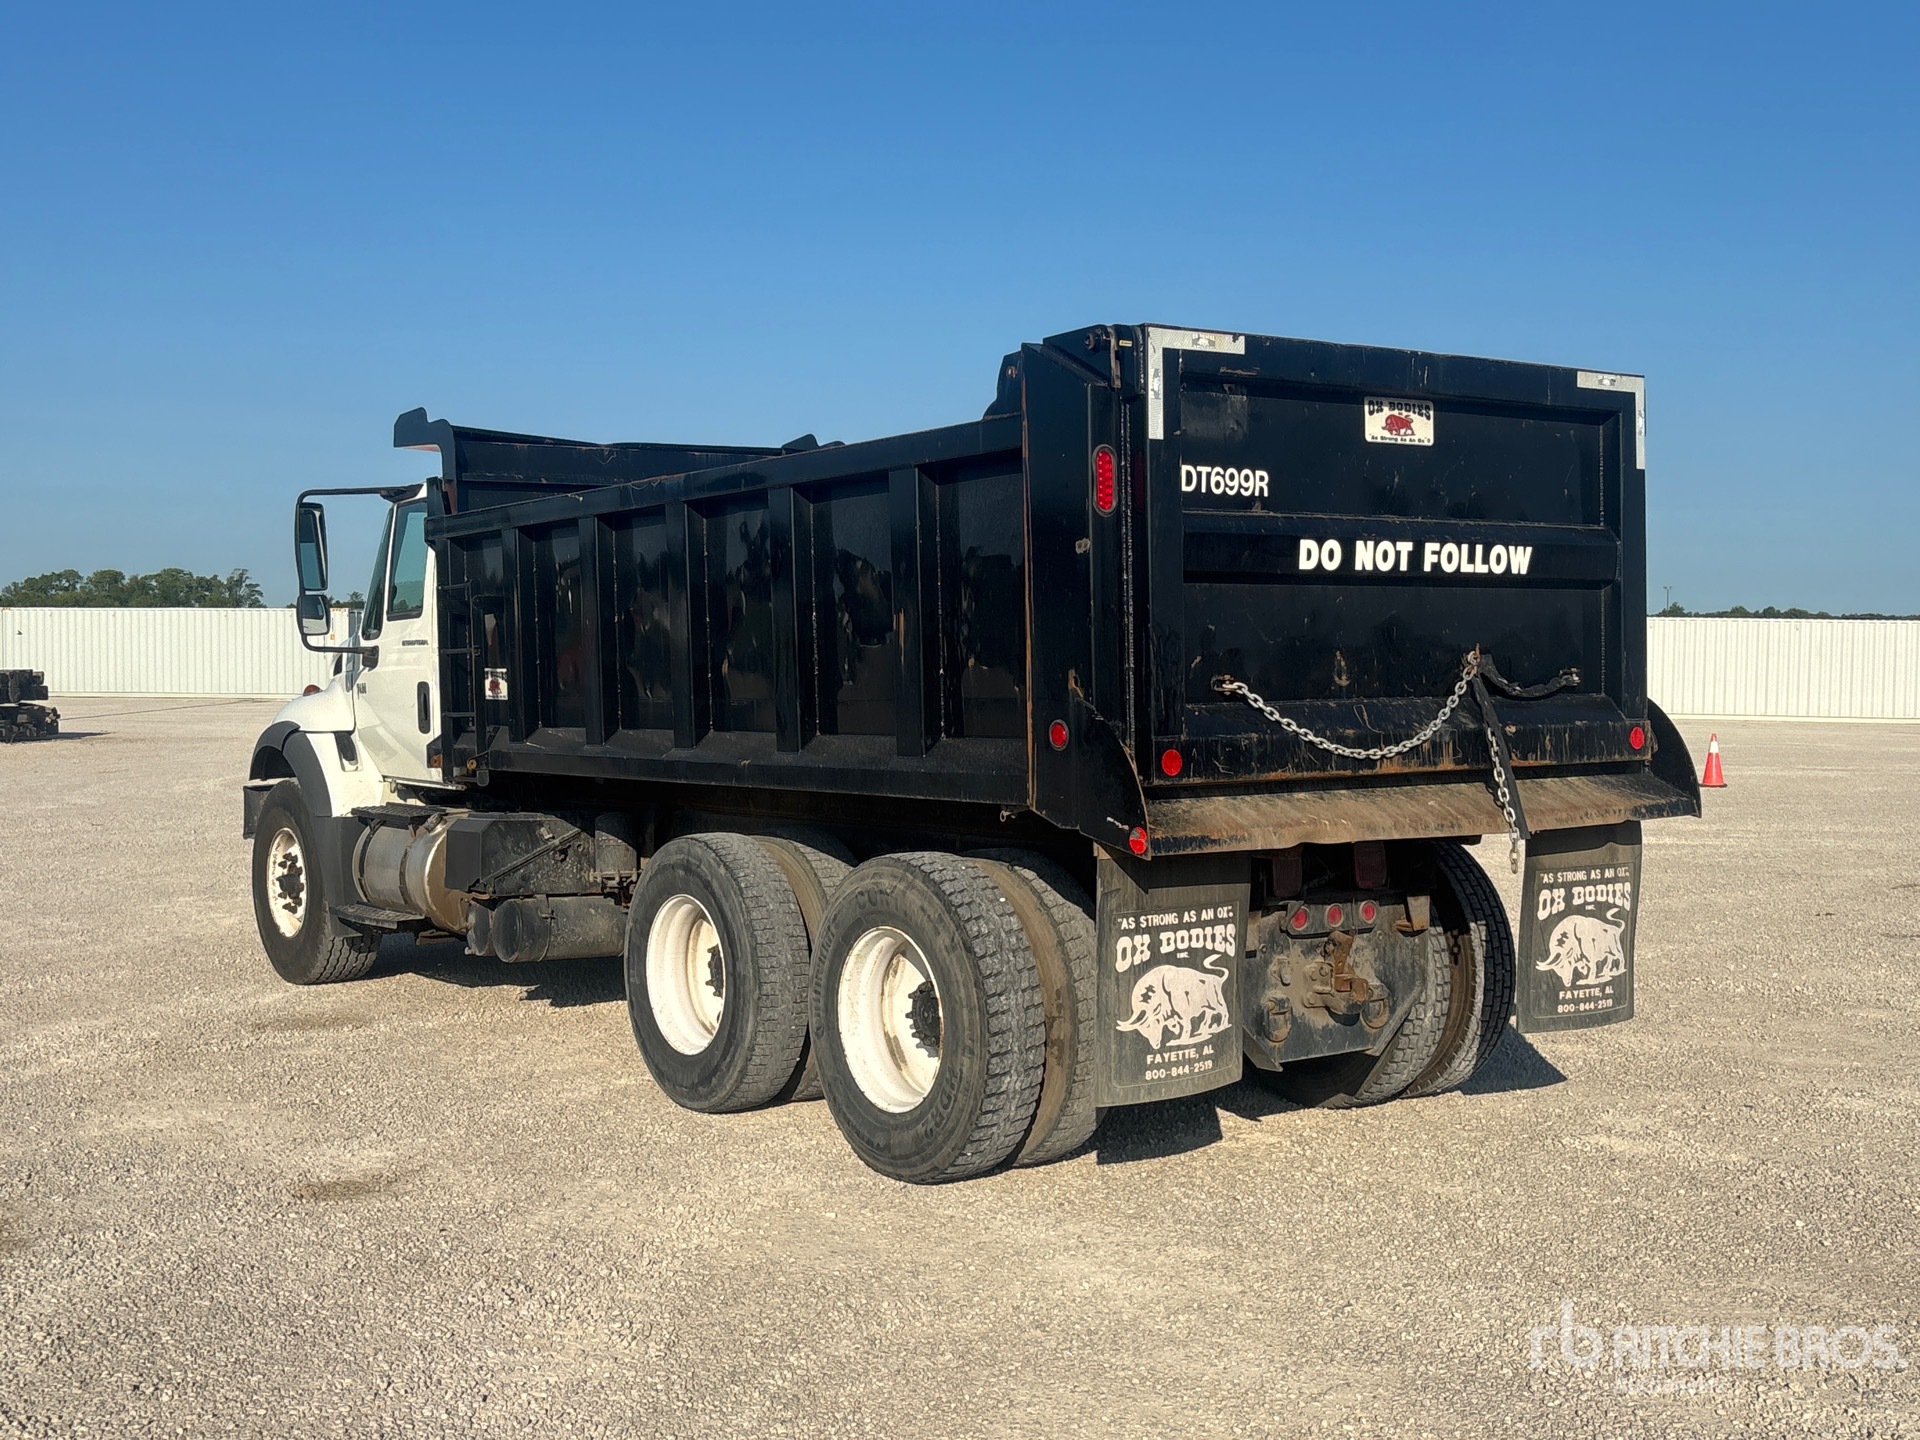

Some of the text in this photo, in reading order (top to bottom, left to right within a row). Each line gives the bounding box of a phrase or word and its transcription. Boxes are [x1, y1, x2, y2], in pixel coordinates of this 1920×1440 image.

[1368, 400, 1431, 421] OX BODIES
[1181, 465, 1269, 497] DT699R
[1298, 539, 1533, 575] DO NOT FOLLOW
[1557, 870, 1587, 883] STRONG
[1590, 869, 1601, 880] AS
[1604, 867, 1615, 879] AN
[1537, 881, 1631, 921] OX BODIES
[1139, 912, 1179, 929] STRONG
[1183, 910, 1197, 924] AS
[1201, 908, 1214, 921] AN
[1116, 923, 1236, 973] OX BODIES
[1604, 985, 1615, 995] AL
[1146, 1045, 1215, 1066] FAYETTE, AL
[1145, 1060, 1213, 1081] 800-844-2519
